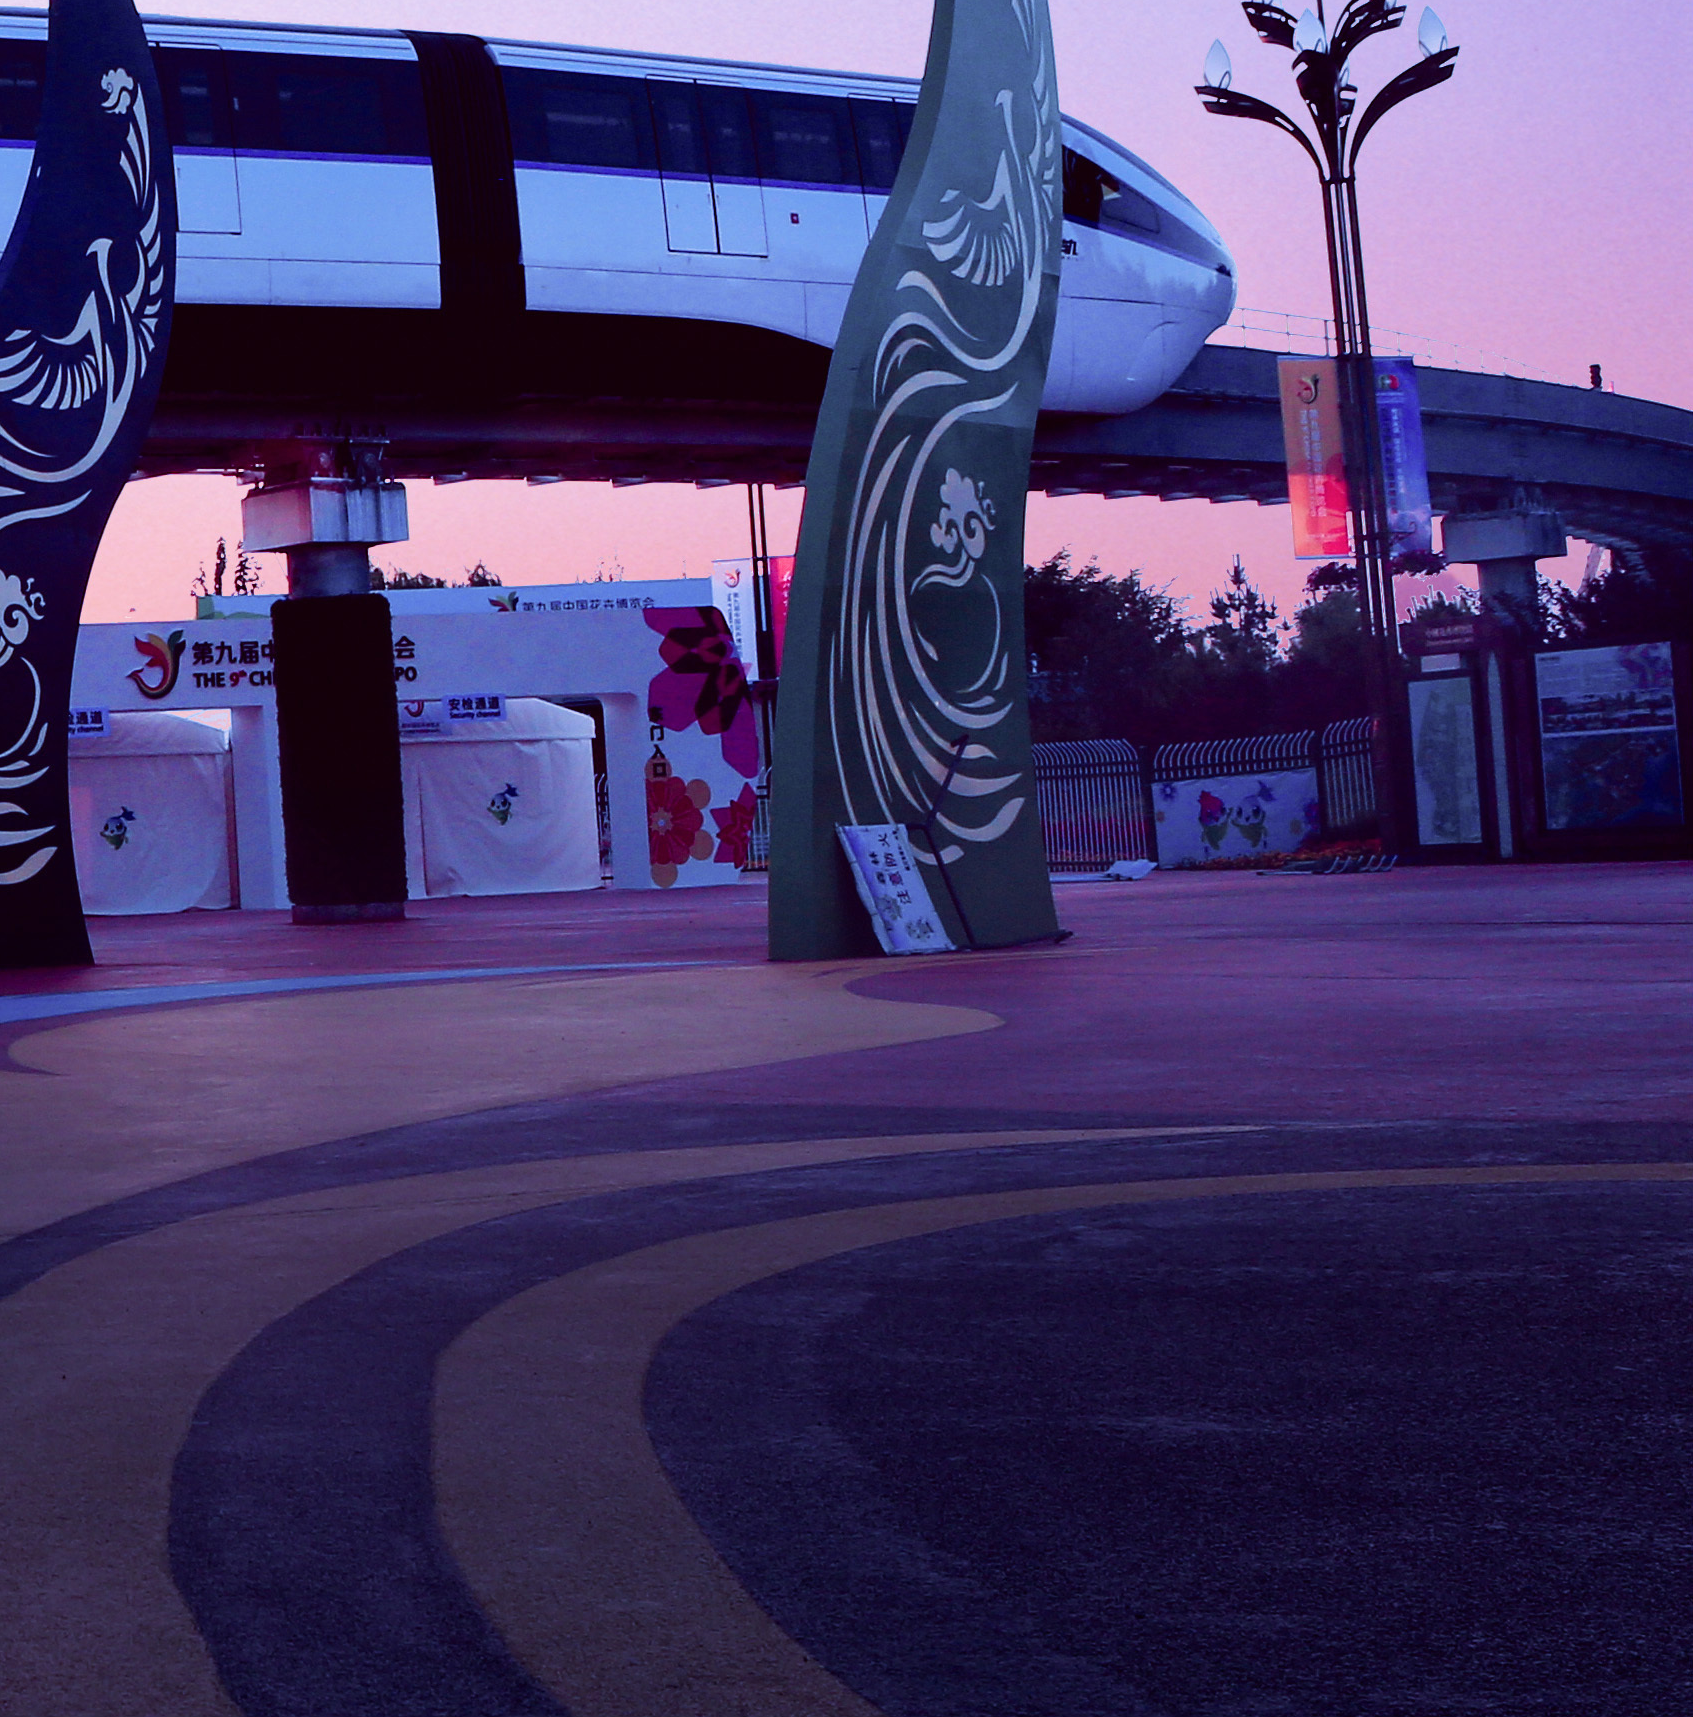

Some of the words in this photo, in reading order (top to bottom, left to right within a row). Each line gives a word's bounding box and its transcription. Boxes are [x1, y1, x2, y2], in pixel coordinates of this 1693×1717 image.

[522, 597, 655, 612] 第九届中国花卉博览会
[192, 672, 226, 688] THE
[249, 670, 276, 686] CHI
[395, 666, 417, 682] PO
[448, 696, 499, 711] 安检通道
